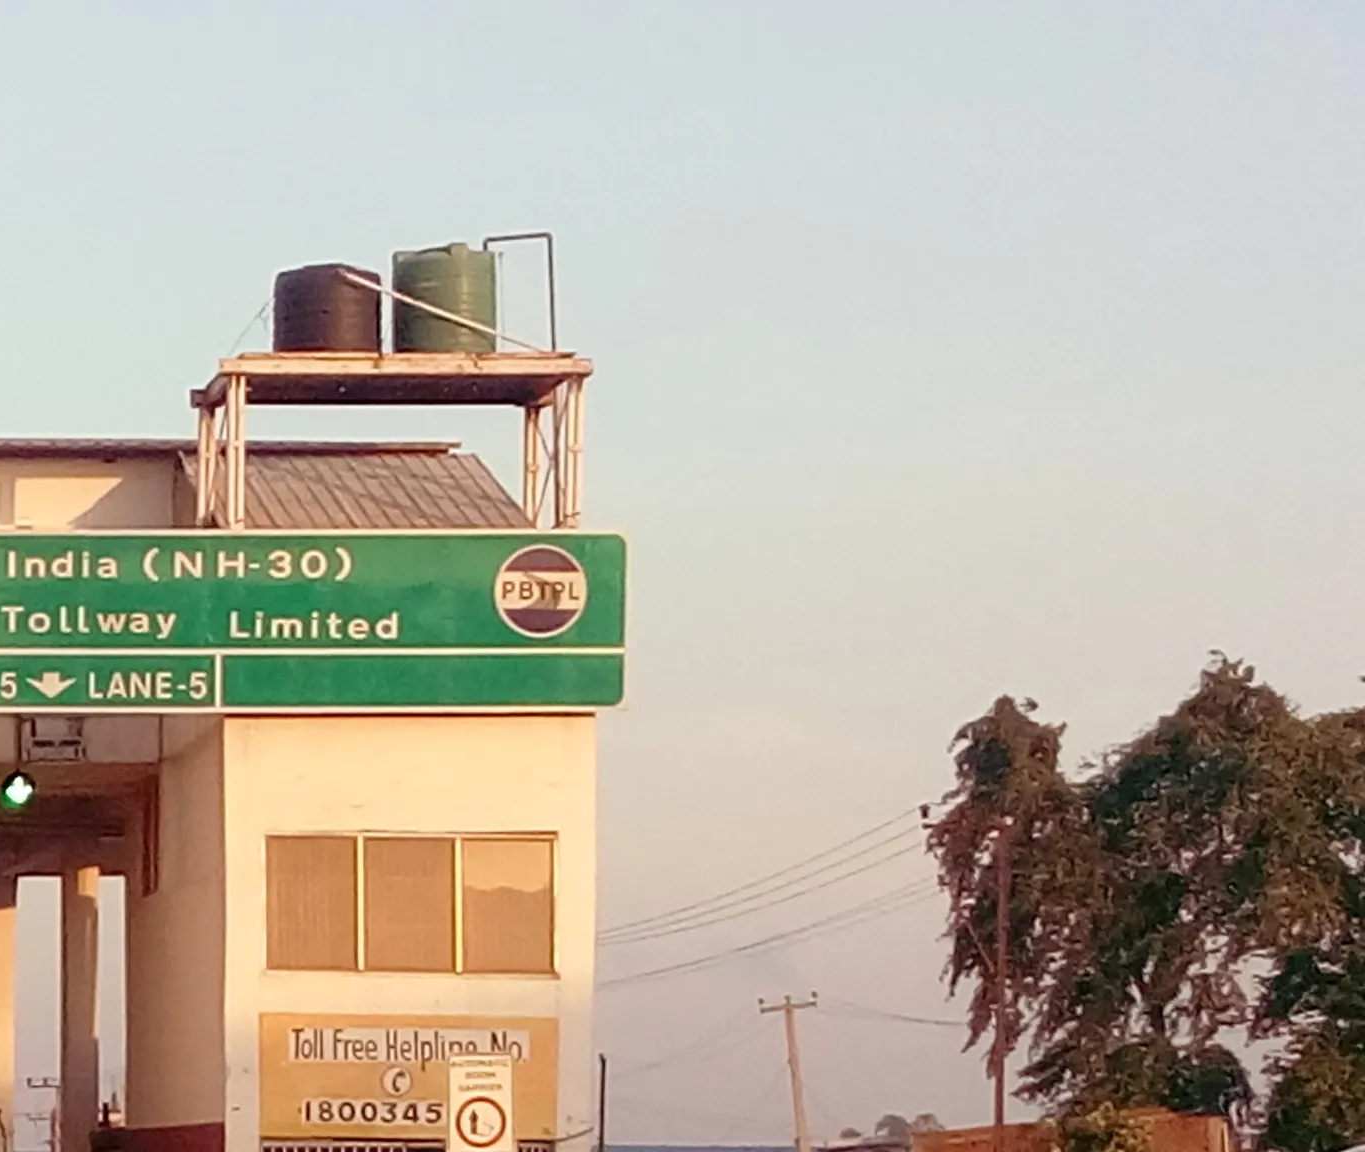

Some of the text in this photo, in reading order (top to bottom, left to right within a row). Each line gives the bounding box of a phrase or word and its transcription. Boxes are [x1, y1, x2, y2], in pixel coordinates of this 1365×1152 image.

[8, 550, 119, 579] India
[142, 546, 353, 582] (NH-30)
[502, 581, 580, 601] PBTPL
[1, 605, 177, 639] Tollway
[229, 611, 399, 640] Limited
[291, 1028, 324, 1060] Toll
[333, 1029, 379, 1062] Free
[305, 1101, 444, 1125] 1800345
